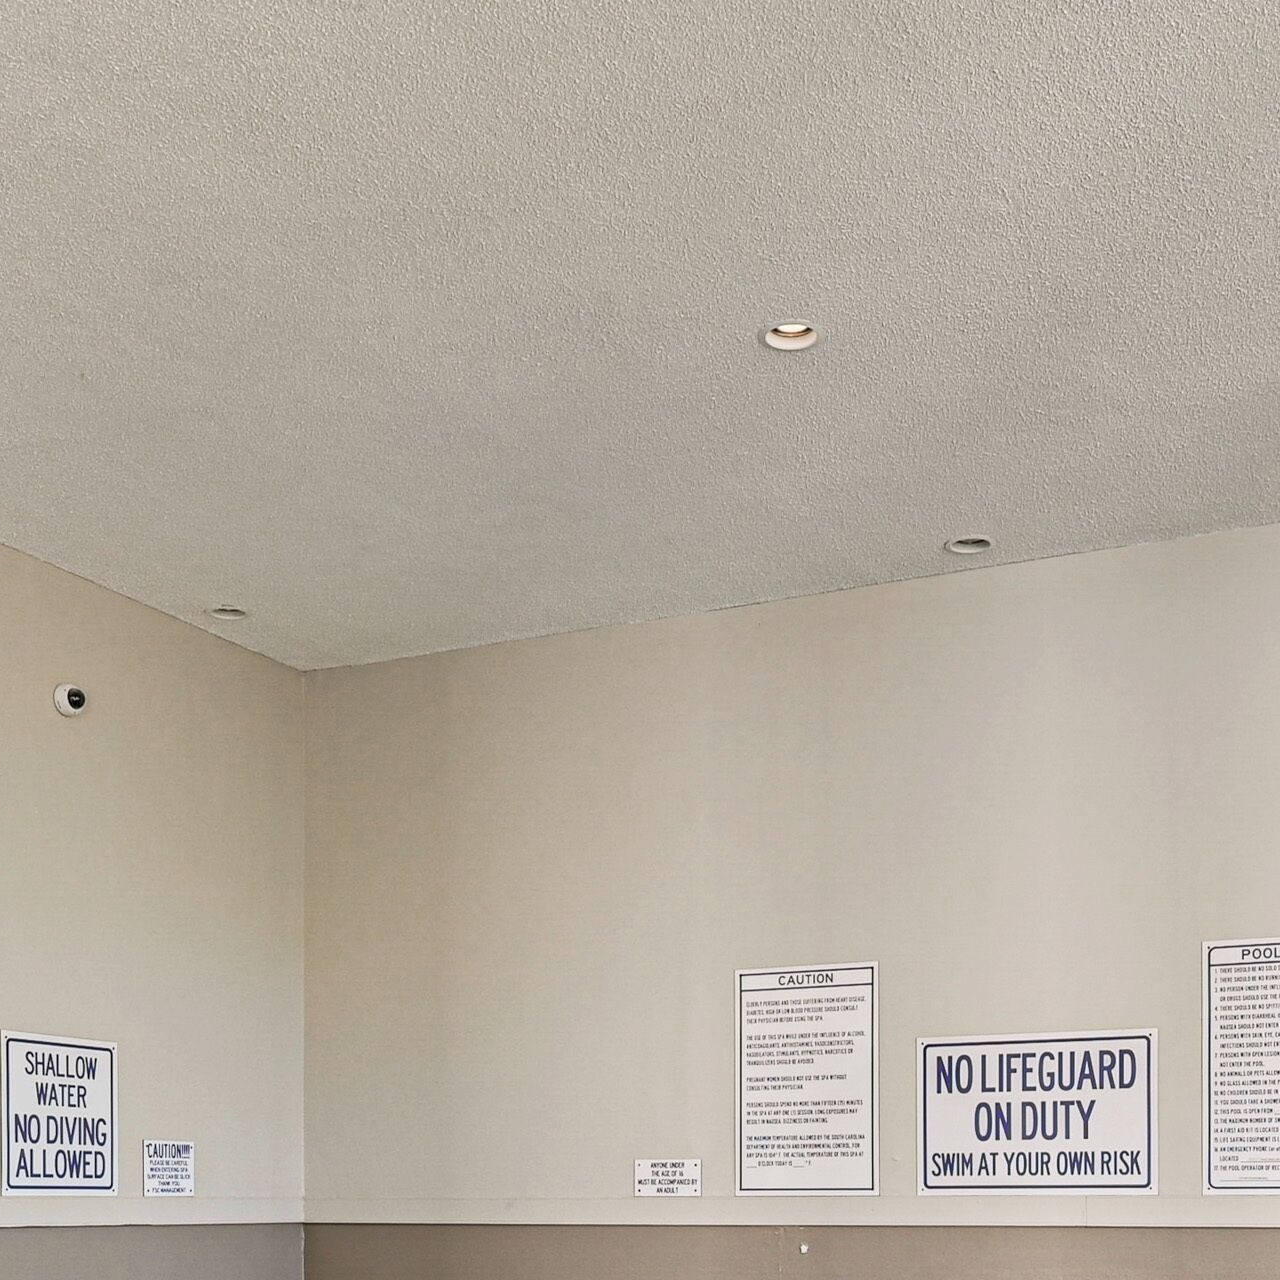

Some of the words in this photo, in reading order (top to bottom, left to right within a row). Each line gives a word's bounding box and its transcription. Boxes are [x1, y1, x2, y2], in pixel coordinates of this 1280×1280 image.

[778, 973, 834, 986] CAUTION
[25, 1051, 97, 1080] SHALLOW
[936, 1054, 973, 1094] NO
[981, 1049, 1137, 1093] LIFEGUARD
[36, 1082, 87, 1108] WATER
[14, 1114, 40, 1144] NO
[47, 1116, 107, 1146] DIVING
[975, 1102, 1011, 1142] ON
[1021, 1100, 1096, 1140] DUTY
[16, 1149, 106, 1178] ALLOWED
[932, 1152, 973, 1176] SWIM
[978, 1152, 999, 1176] AT
[1003, 1152, 1050, 1176] YOUR
[1057, 1151, 1095, 1176] OWN
[1101, 1150, 1141, 1176] RISK
